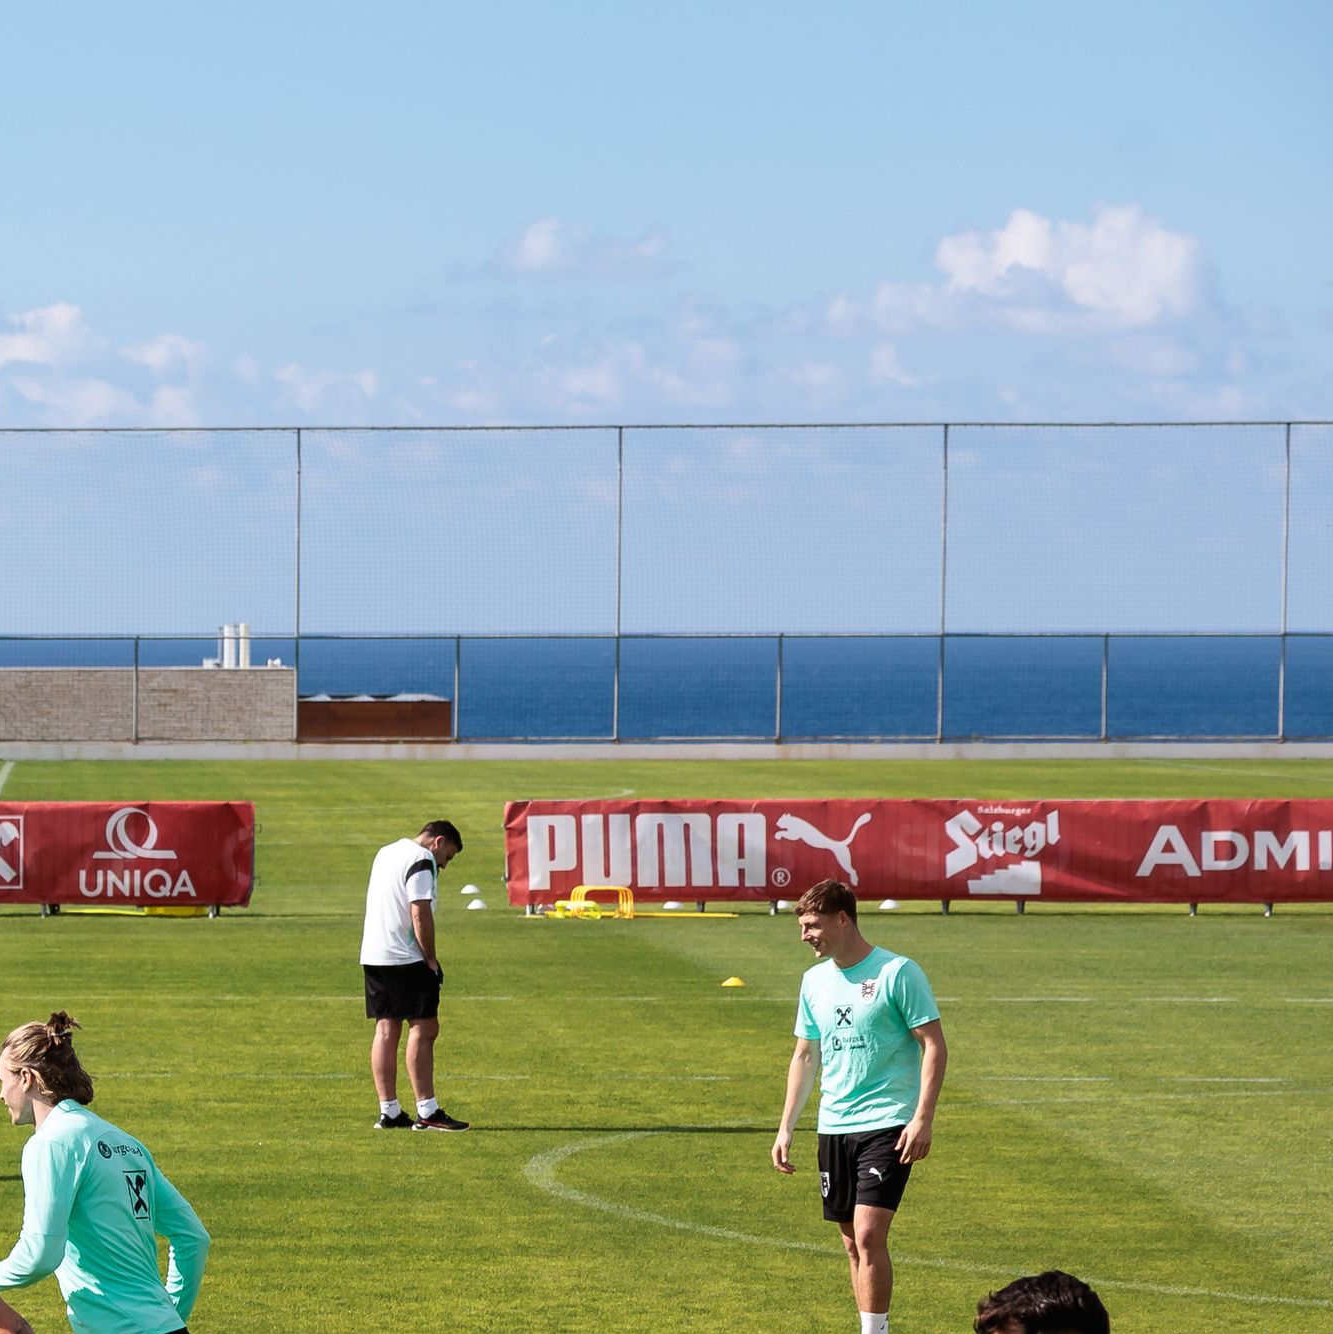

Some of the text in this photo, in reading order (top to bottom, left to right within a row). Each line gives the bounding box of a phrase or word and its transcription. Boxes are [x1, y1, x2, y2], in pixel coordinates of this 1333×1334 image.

[527, 813, 767, 890] PUMA
[944, 809, 1061, 879] Stiegl
[79, 869, 197, 897] UNIQA
